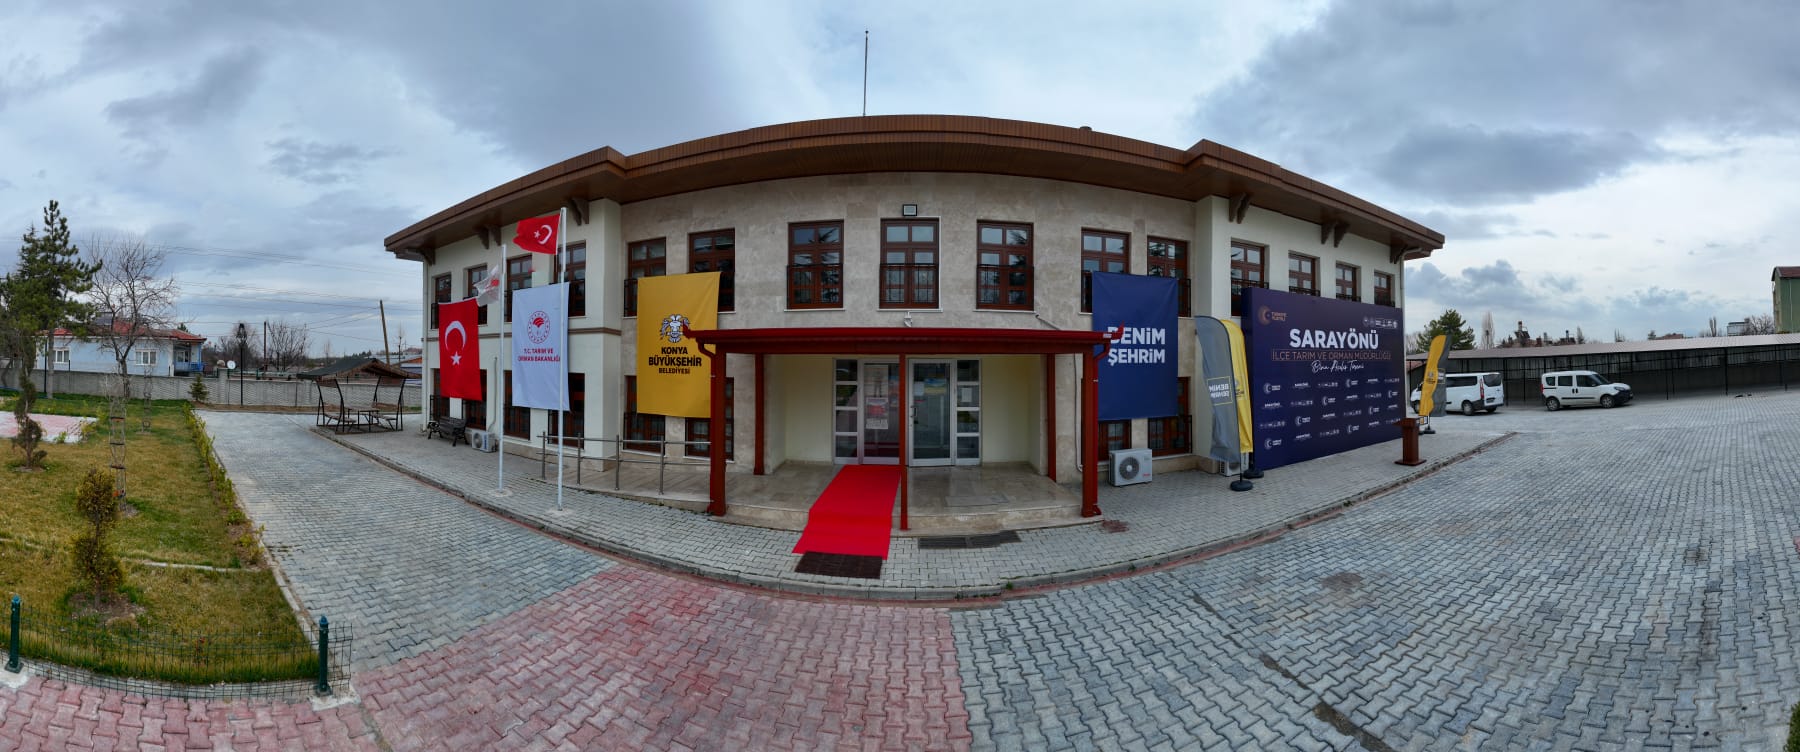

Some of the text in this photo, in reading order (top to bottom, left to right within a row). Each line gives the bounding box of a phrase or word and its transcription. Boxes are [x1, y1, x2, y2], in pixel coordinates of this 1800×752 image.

[1289, 328, 1378, 349] SARAYÖNÜ
[661, 346, 689, 355] KONYA
[1292, 351, 1316, 360] TARIM
[1317, 351, 1327, 360] VE
[1328, 351, 1353, 360] ORMAN
[648, 354, 702, 367] BÜYÜKŞEHİR
[658, 367, 691, 375] BELEDİYESİ
